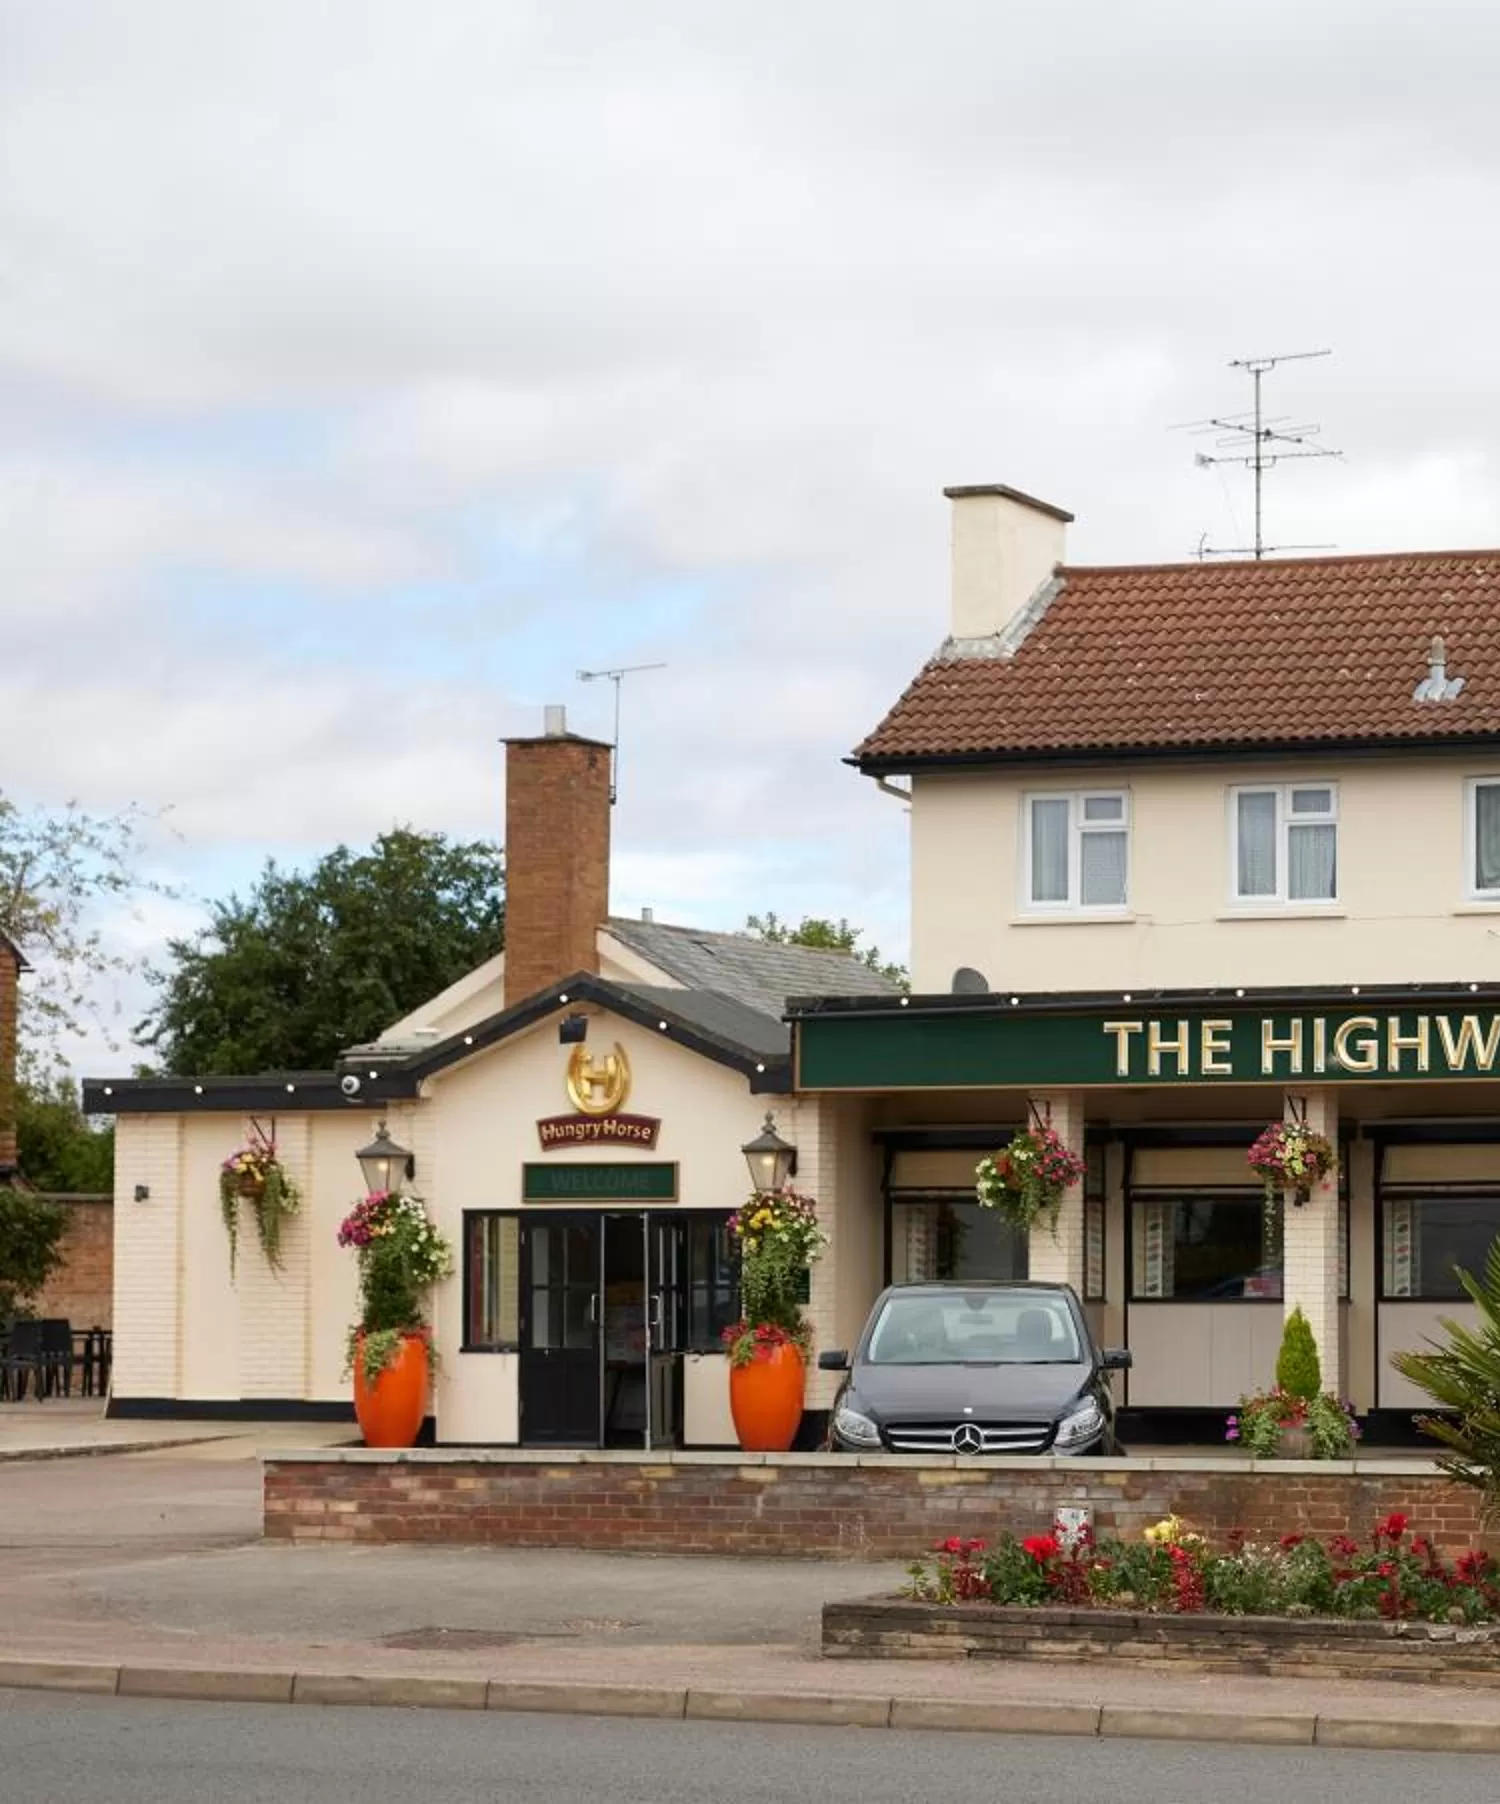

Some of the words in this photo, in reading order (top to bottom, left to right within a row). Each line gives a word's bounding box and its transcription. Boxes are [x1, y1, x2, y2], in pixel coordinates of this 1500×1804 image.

[1103, 1019, 1233, 1077] THE
[541, 1121, 601, 1141] Hungry
[603, 1119, 651, 1140] Horse
[550, 1167, 650, 1192] WELCOME
